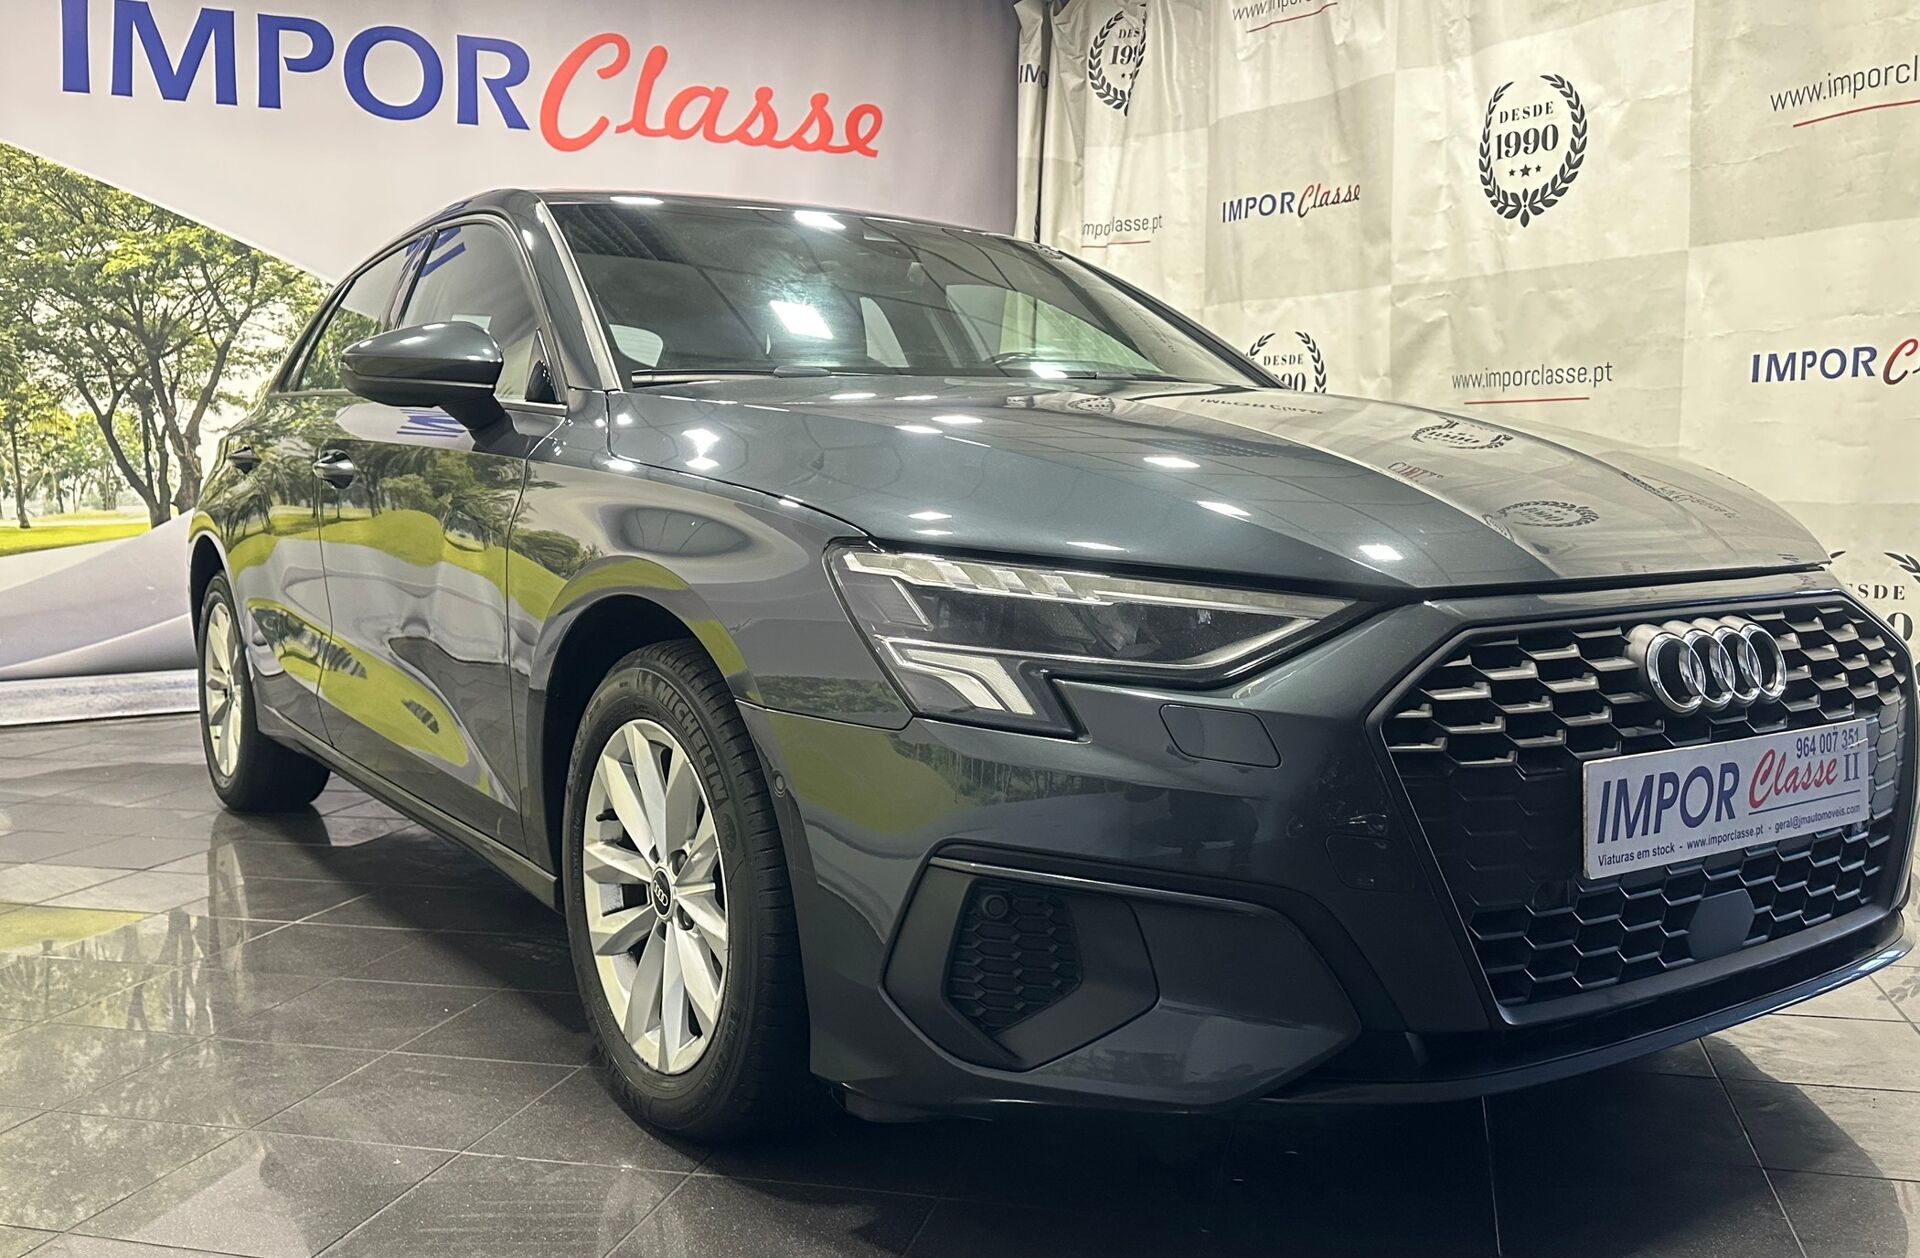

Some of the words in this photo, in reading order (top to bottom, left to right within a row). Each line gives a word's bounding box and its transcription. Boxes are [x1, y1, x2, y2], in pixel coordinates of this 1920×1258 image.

[60, 0, 530, 130] IMPOR
[540, 32, 884, 158] Classe
[1499, 101, 1554, 124] DESDE
[1496, 124, 1559, 160] 1990
[1222, 191, 1295, 223] IMPOR
[1297, 183, 1360, 218] Classe
[1263, 353, 1304, 366] DESDE
[1452, 362, 1613, 392] www.imporclasse.pt
[1751, 346, 1878, 383] IMPOR
[655, 682, 729, 804] MICHELIN
[1796, 735, 1816, 759] 964
[1819, 731, 1839, 754] 007
[1841, 727, 1861, 750] 351
[1597, 761, 1740, 844] IMPOR
[1749, 748, 1838, 809] Classe
[1598, 850, 1635, 867] Viaturas
[1636, 849, 1650, 860] em
[1652, 842, 1675, 857] stock
[1686, 824, 1764, 850] www.imporclasse.pt
[1774, 804, 1860, 834] geral@jmautomoveis.com
